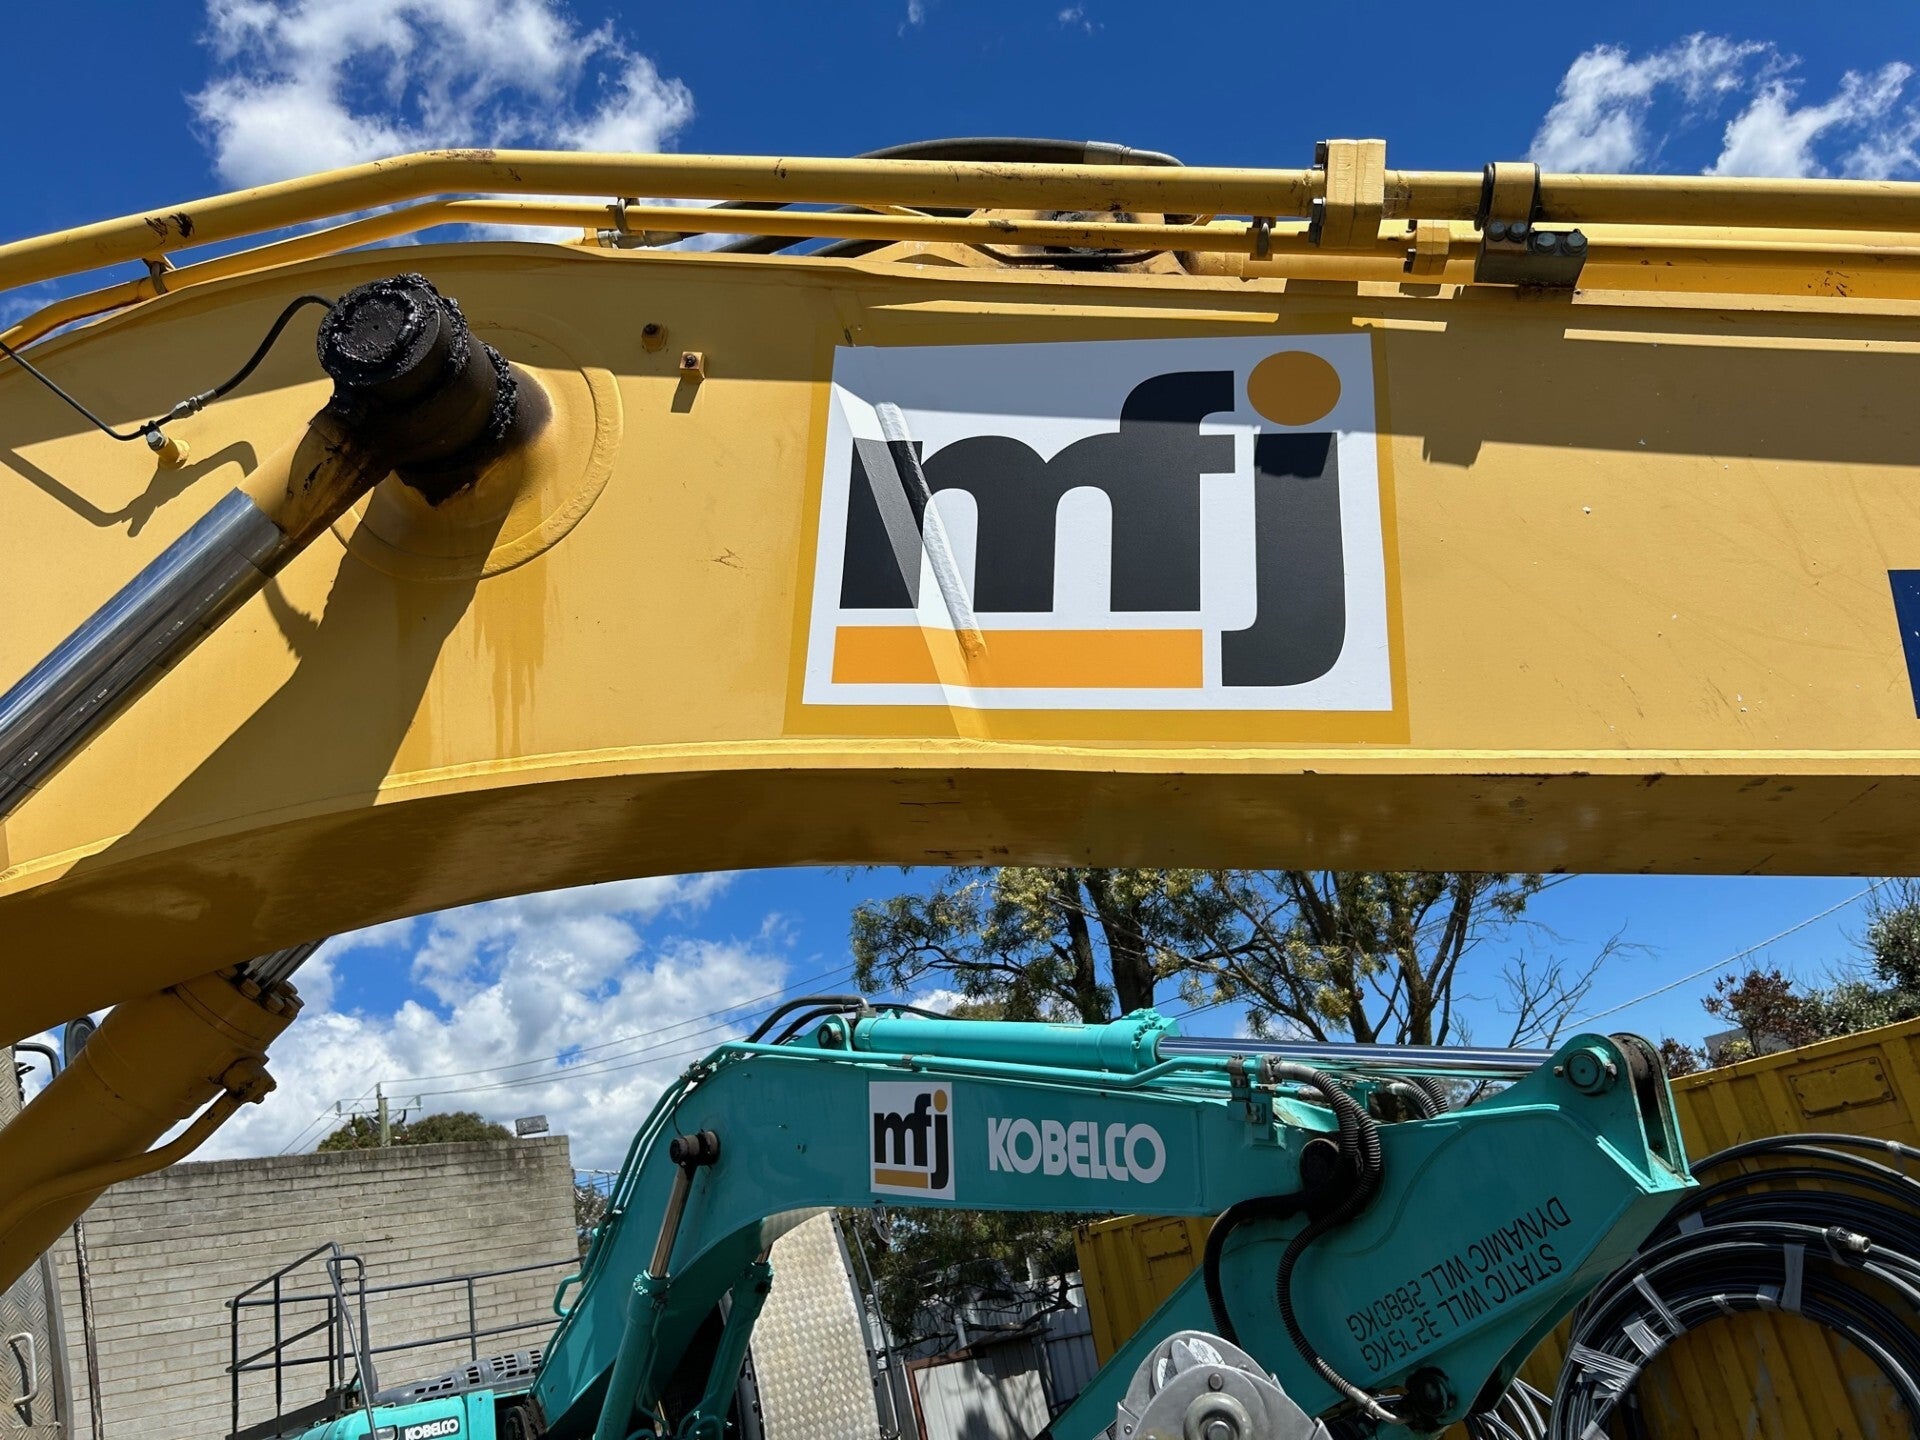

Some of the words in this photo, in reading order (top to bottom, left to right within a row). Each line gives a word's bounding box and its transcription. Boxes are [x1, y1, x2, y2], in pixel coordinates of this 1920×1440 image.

[839, 351, 1347, 687] mfj
[873, 1088, 950, 1190] mfj
[987, 1117, 1166, 1184] KOBELCO
[1468, 1196, 1573, 1273] DYNAMIC
[1421, 1254, 1473, 1296] WLL
[1485, 1243, 1563, 1304] STATIC
[1437, 1285, 1491, 1327] WLL
[1360, 1310, 1442, 1372] 3275KG
[405, 1419, 458, 1440] KOBELCO
